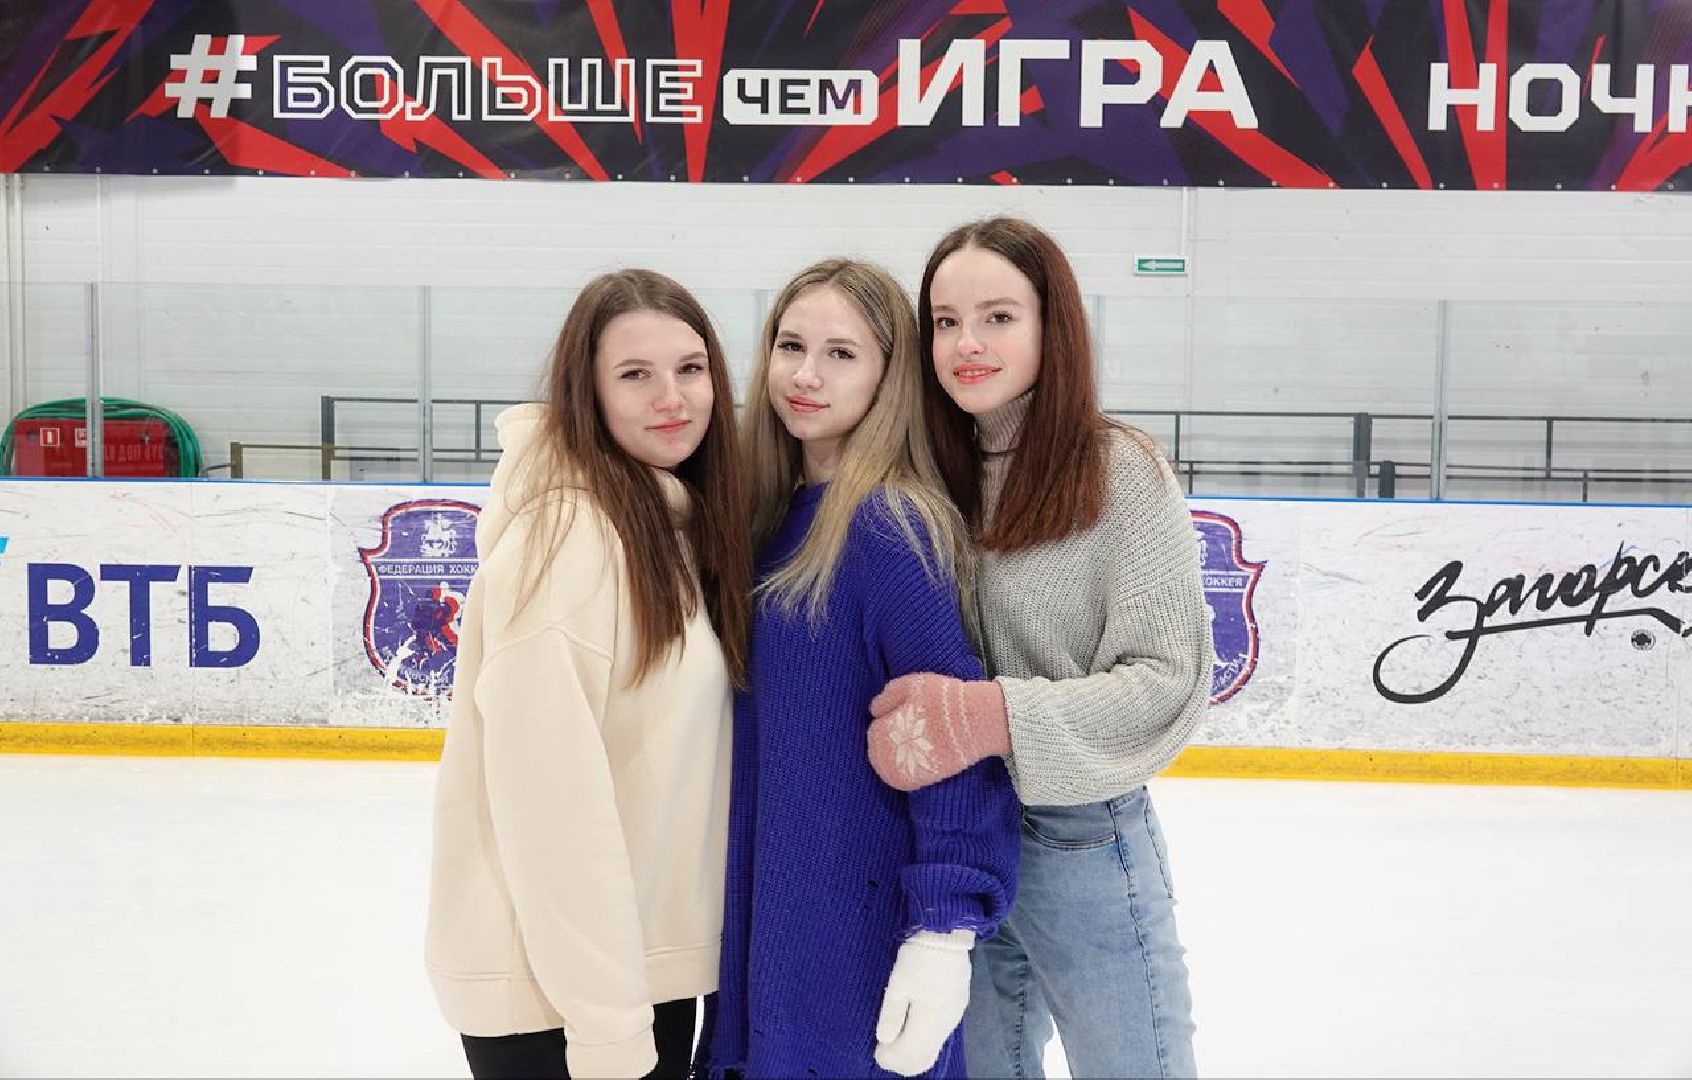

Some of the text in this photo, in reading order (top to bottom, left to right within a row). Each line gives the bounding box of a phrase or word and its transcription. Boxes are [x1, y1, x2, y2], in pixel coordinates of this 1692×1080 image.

[164, 33, 1260, 129] #БОЛЬШЕ ЧЕМ ИГРА
[378, 562, 445, 576] ФЕДЕРАЦИЯ
[1202, 576, 1243, 588] ОККЕЯ
[27, 562, 261, 668] ВТБ
